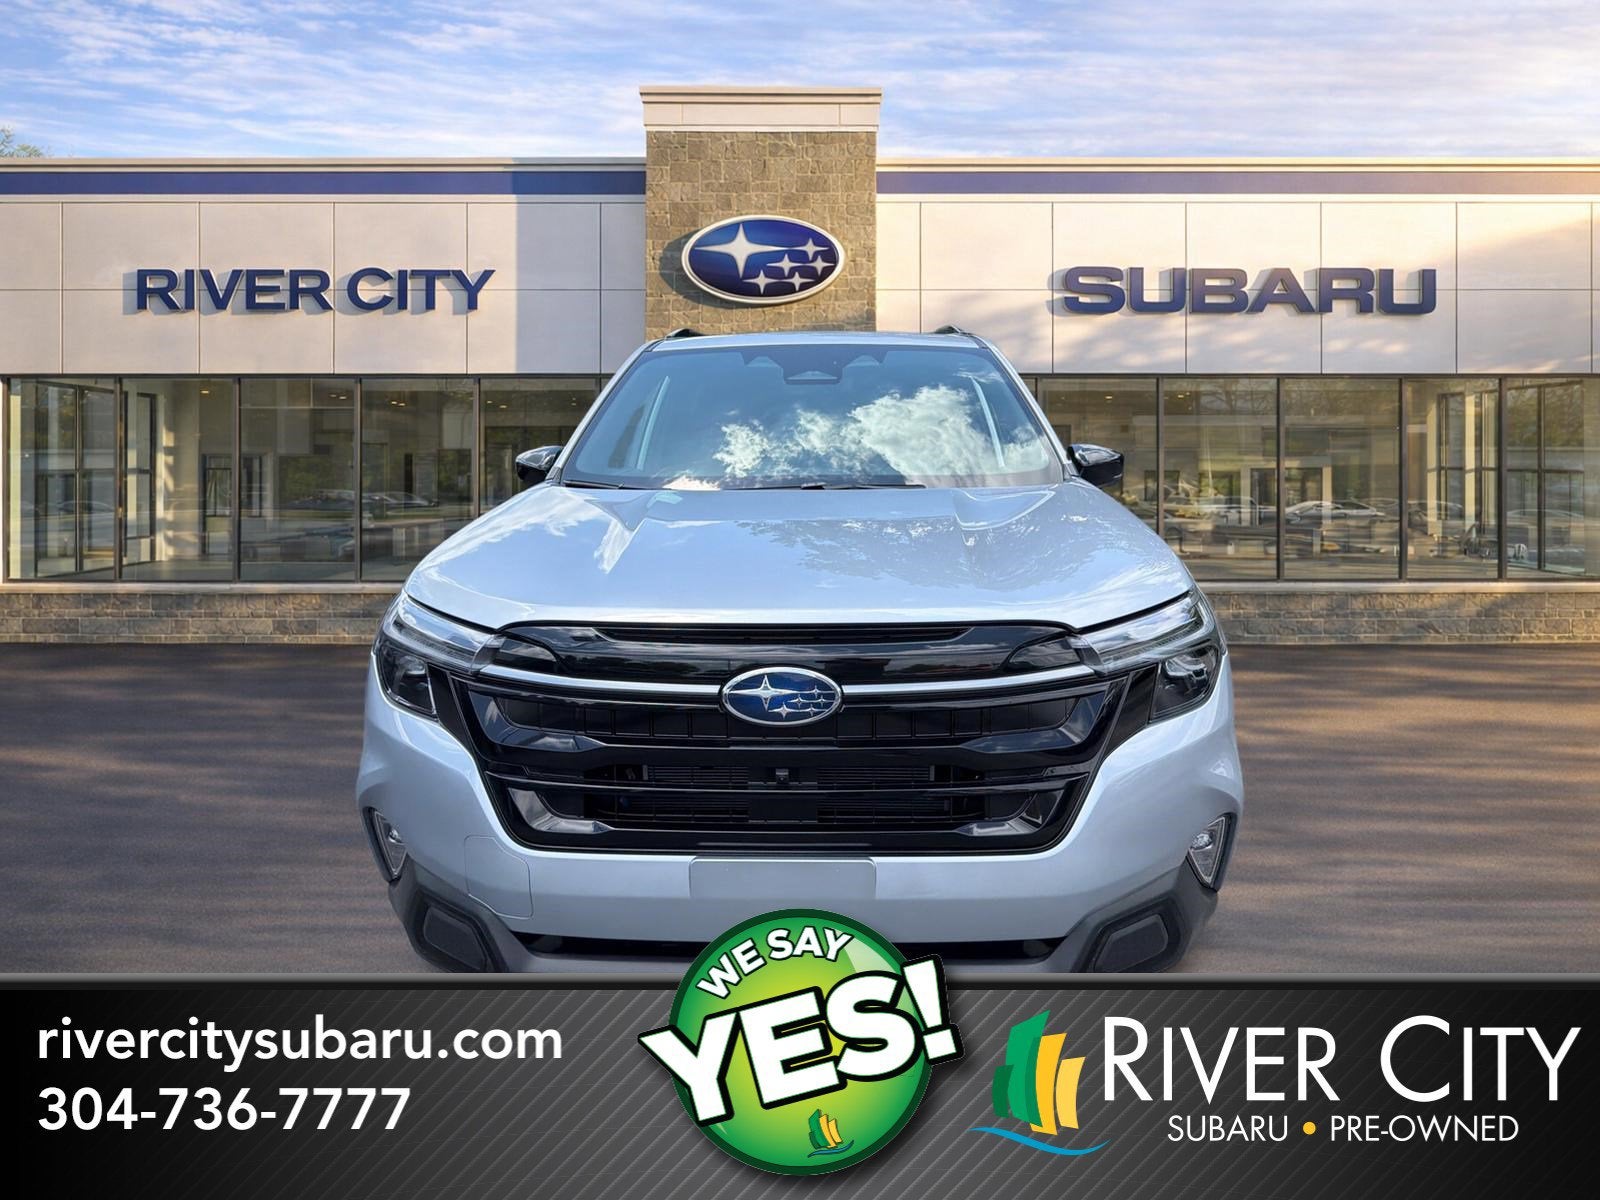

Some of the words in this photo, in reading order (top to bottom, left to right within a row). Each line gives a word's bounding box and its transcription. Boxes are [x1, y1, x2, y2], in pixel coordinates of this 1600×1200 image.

[136, 268, 333, 311] RIVER
[347, 267, 496, 311] CITY
[1063, 266, 1437, 315] SUBARU
